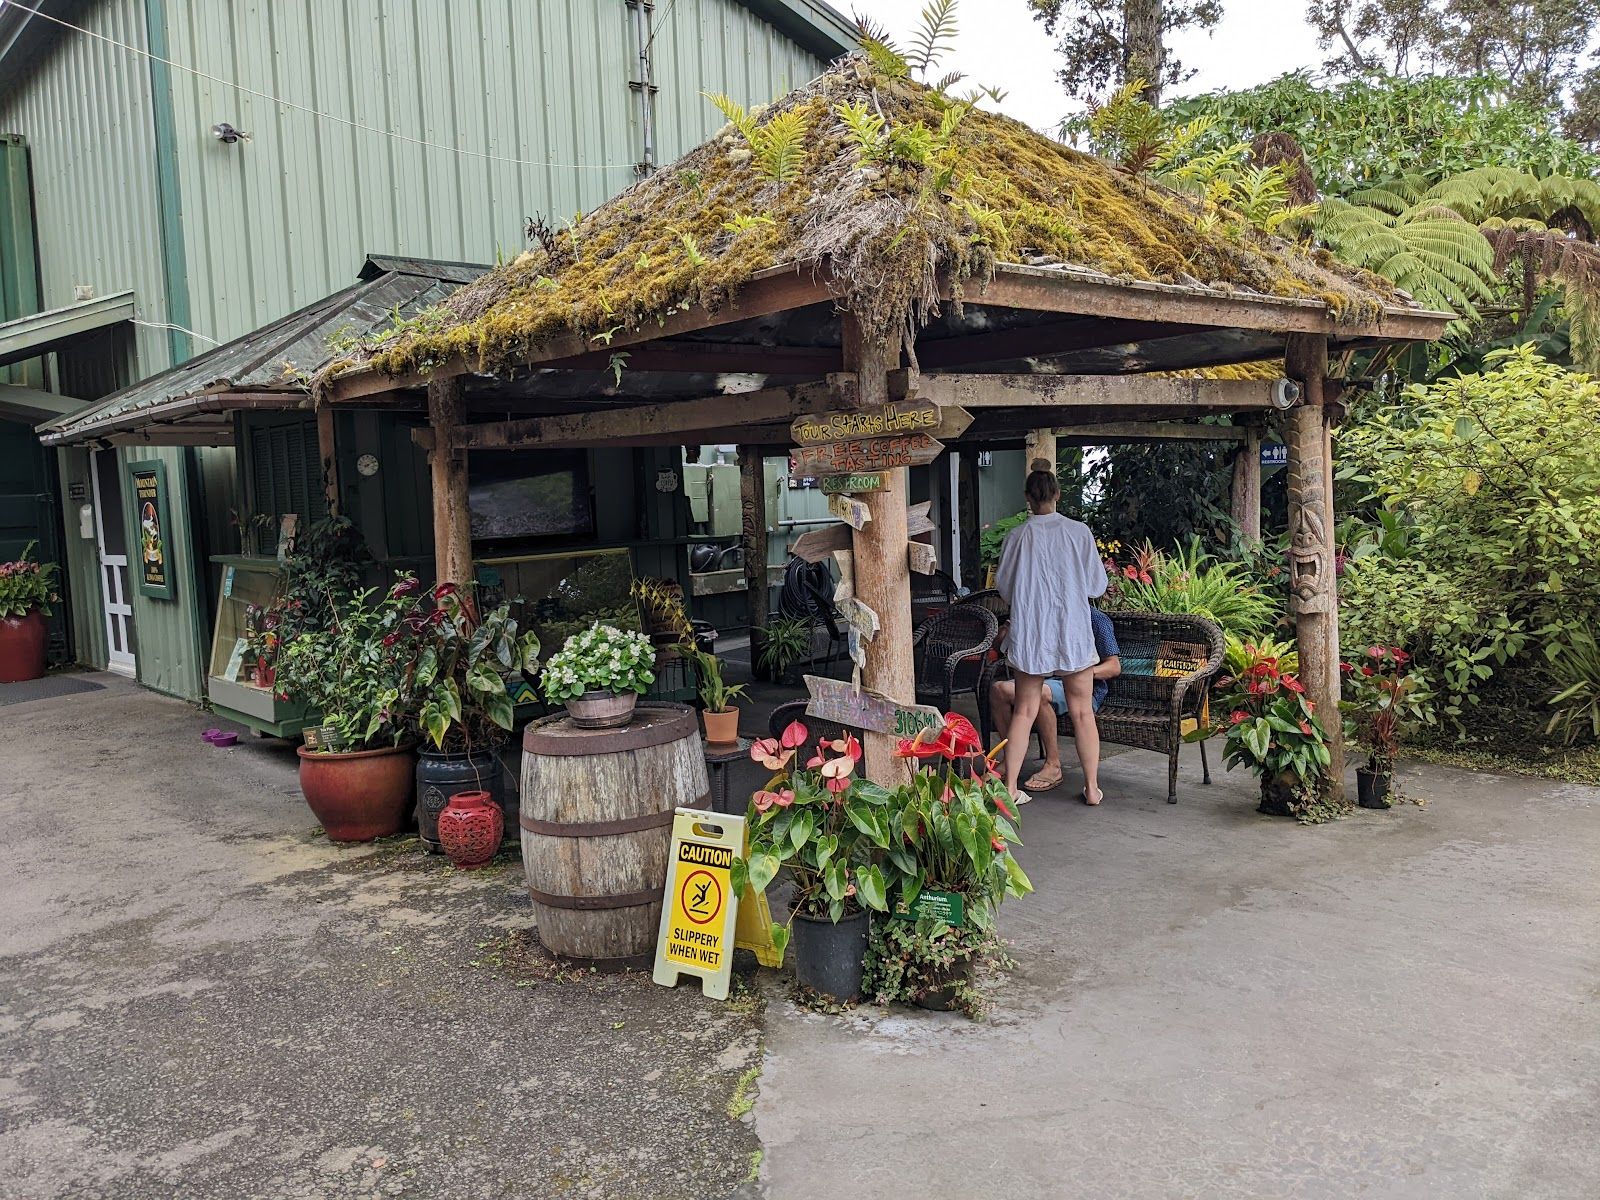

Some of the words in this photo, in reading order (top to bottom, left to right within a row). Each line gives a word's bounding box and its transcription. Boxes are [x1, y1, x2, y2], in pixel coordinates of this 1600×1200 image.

[793, 421, 831, 441] TOUR
[884, 404, 936, 432] HERE
[802, 441, 862, 465] FREE
[869, 435, 933, 453] COFFEE
[831, 451, 912, 472] TASTING
[823, 476, 880, 491] RESTROOM
[1163, 659, 1199, 671] CAUTION
[680, 844, 731, 868] CAUTION
[673, 927, 719, 948] SLIPPERY
[669, 942, 697, 960] WHEN
[699, 948, 720, 965] WET
